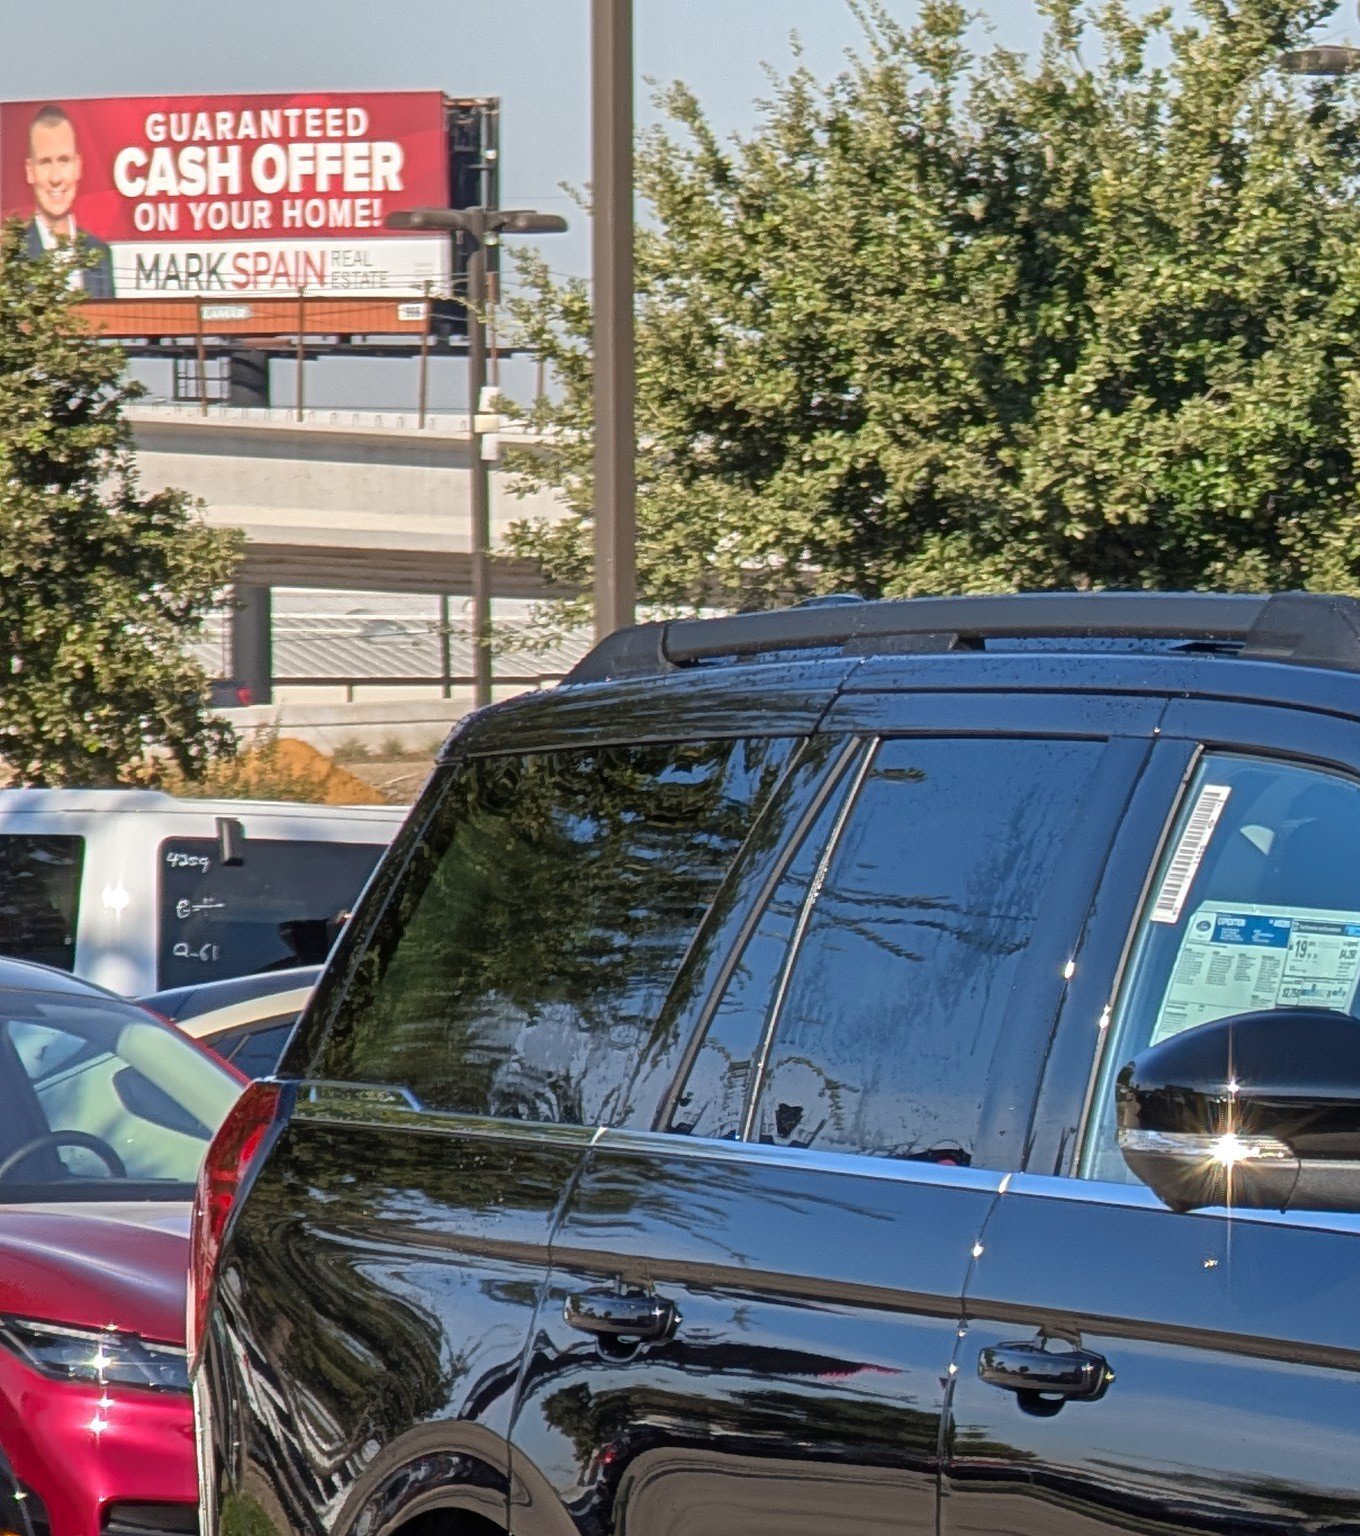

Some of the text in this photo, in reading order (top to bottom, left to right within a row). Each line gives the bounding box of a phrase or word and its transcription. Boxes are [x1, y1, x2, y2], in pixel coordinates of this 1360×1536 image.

[145, 107, 370, 142] GUARANTEED
[114, 142, 404, 197] CASH OFFER
[134, 197, 384, 232] ON YOUR HOME!
[135, 250, 327, 292] MARK SPAIN
[331, 249, 373, 268] REAL
[331, 269, 390, 289] ESTATE
